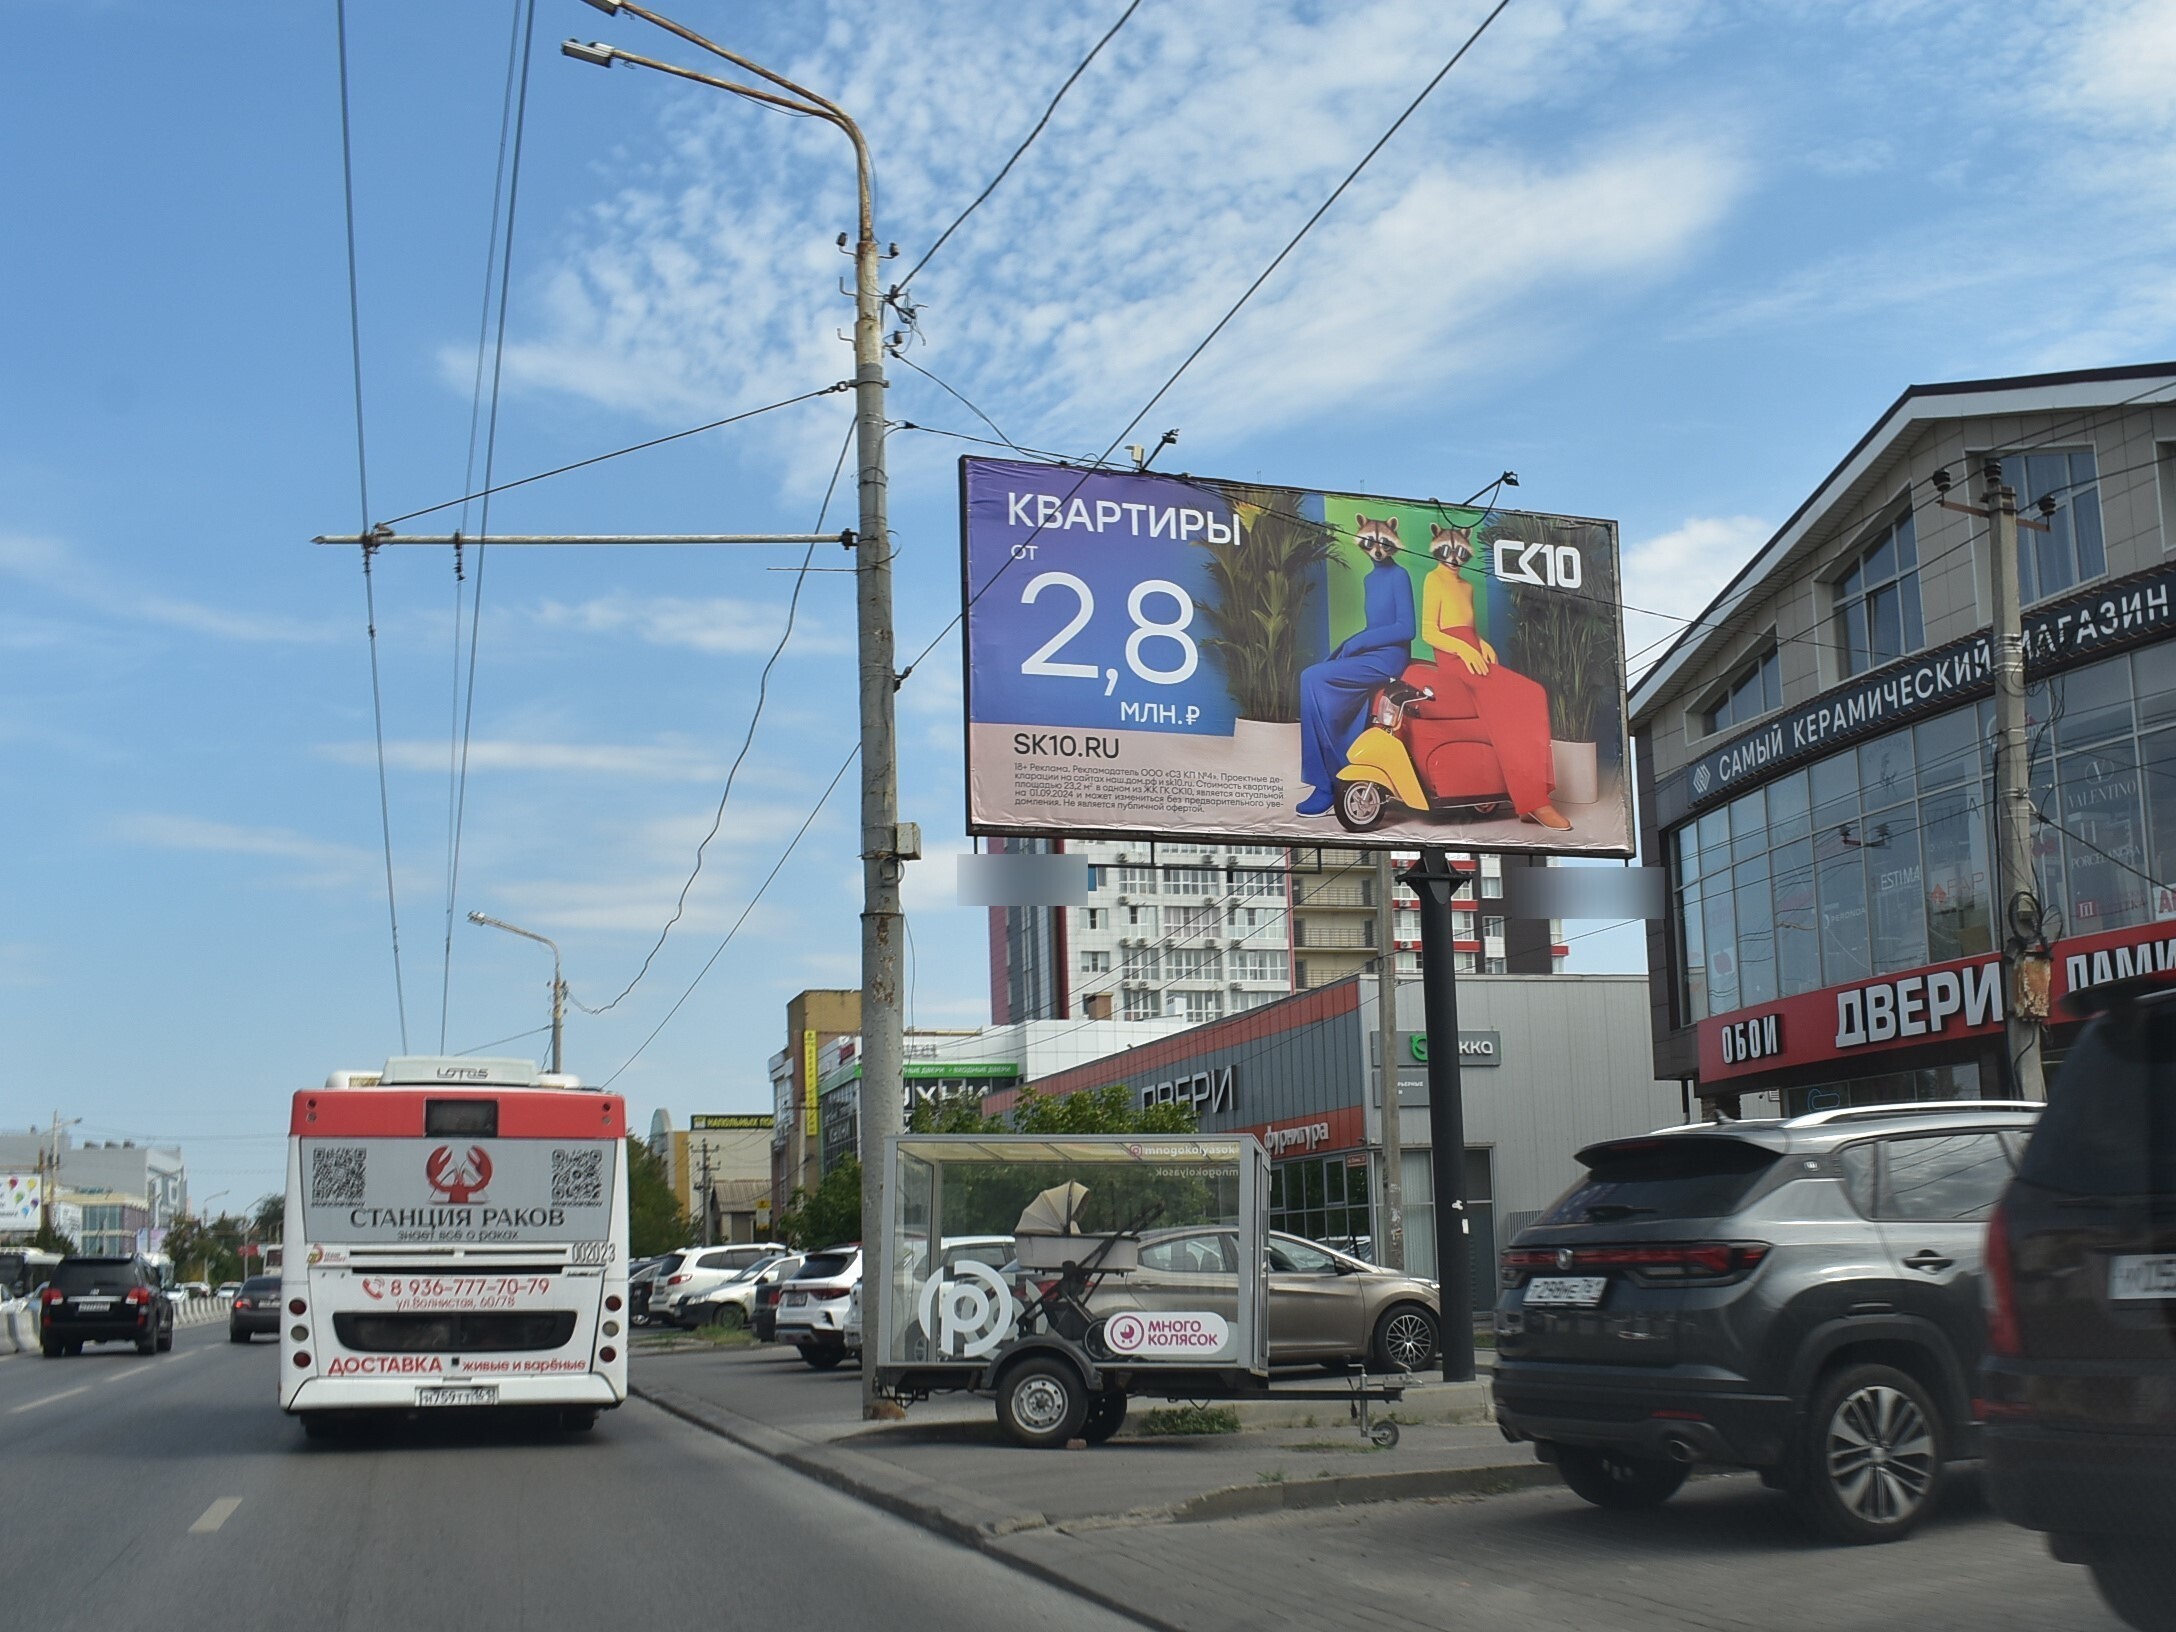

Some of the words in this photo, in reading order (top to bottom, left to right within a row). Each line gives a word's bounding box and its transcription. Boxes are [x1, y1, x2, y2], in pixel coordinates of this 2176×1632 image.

[1008, 492, 1241, 546] КВАРТИРЫ
[1010, 544, 1039, 560] ОТ
[1020, 571, 1199, 696] 2,8
[1719, 723, 1784, 782] САМЫЙ
[1793, 638, 1992, 749] КЕРАМИЧЕСКИЙ
[1014, 732, 1120, 759] SK10.RU
[1014, 762, 1028, 772] 18+
[1029, 763, 1071, 773] Реклама.
[1072, 765, 1140, 777] Рекламодатель
[1140, 768, 1163, 778] ООО
[1183, 771, 1196, 779] КП
[1220, 772, 1268, 783] Проектные
[1269, 776, 1284, 784] де-
[1014, 772, 1059, 782] кларации
[1073, 773, 1105, 783] сайтах
[1195, 779, 1242, 790] Стоимость
[1242, 783, 1284, 792] квартиры
[1014, 781, 1063, 790] площадью
[1063, 781, 1082, 791] 23,2
[1102, 785, 1131, 793] одном
[1143, 786, 1159, 794] ЖК
[1159, 786, 1171, 795] ГК
[1171, 786, 1195, 797] СК10,
[1195, 788, 1234, 797] является
[1234, 791, 1284, 800] актуальной
[1014, 789, 1027, 797] на
[1029, 789, 1074, 798] 01.09.2024
[1084, 792, 1113, 800] может
[1114, 794, 1165, 802] измениться
[1166, 795, 1182, 803] без
[1184, 796, 1265, 807] предварительного
[1266, 801, 1284, 809] уве-
[2067, 780, 2137, 810] VALENTINO
[1014, 798, 1061, 807] домления.
[1063, 799, 1076, 807] Не
[1077, 800, 1116, 809] является
[1117, 801, 1165, 811] публичной
[1165, 803, 1205, 813] офертой.
[1880, 865, 1920, 890] ESTIMA
[1721, 1015, 1778, 1064] ОБОИ
[1835, 961, 2004, 1049] ДВЕРИ
[1263, 1120, 1330, 1156] фурнитура
[1144, 1144, 1236, 1160] mnogokolyasok
[350, 1208, 471, 1230] СТАНЦИЯ
[481, 1207, 566, 1228] РАКОВ
[390, 1278, 403, 1297] 8
[408, 1277, 550, 1297] 936-777-70-79
[1148, 1320, 1202, 1333] МНОГО
[1148, 1333, 1218, 1346] КОЛЯСОК
[327, 1356, 443, 1376] ДОСТАВКА
[512, 1361, 522, 1370] и
